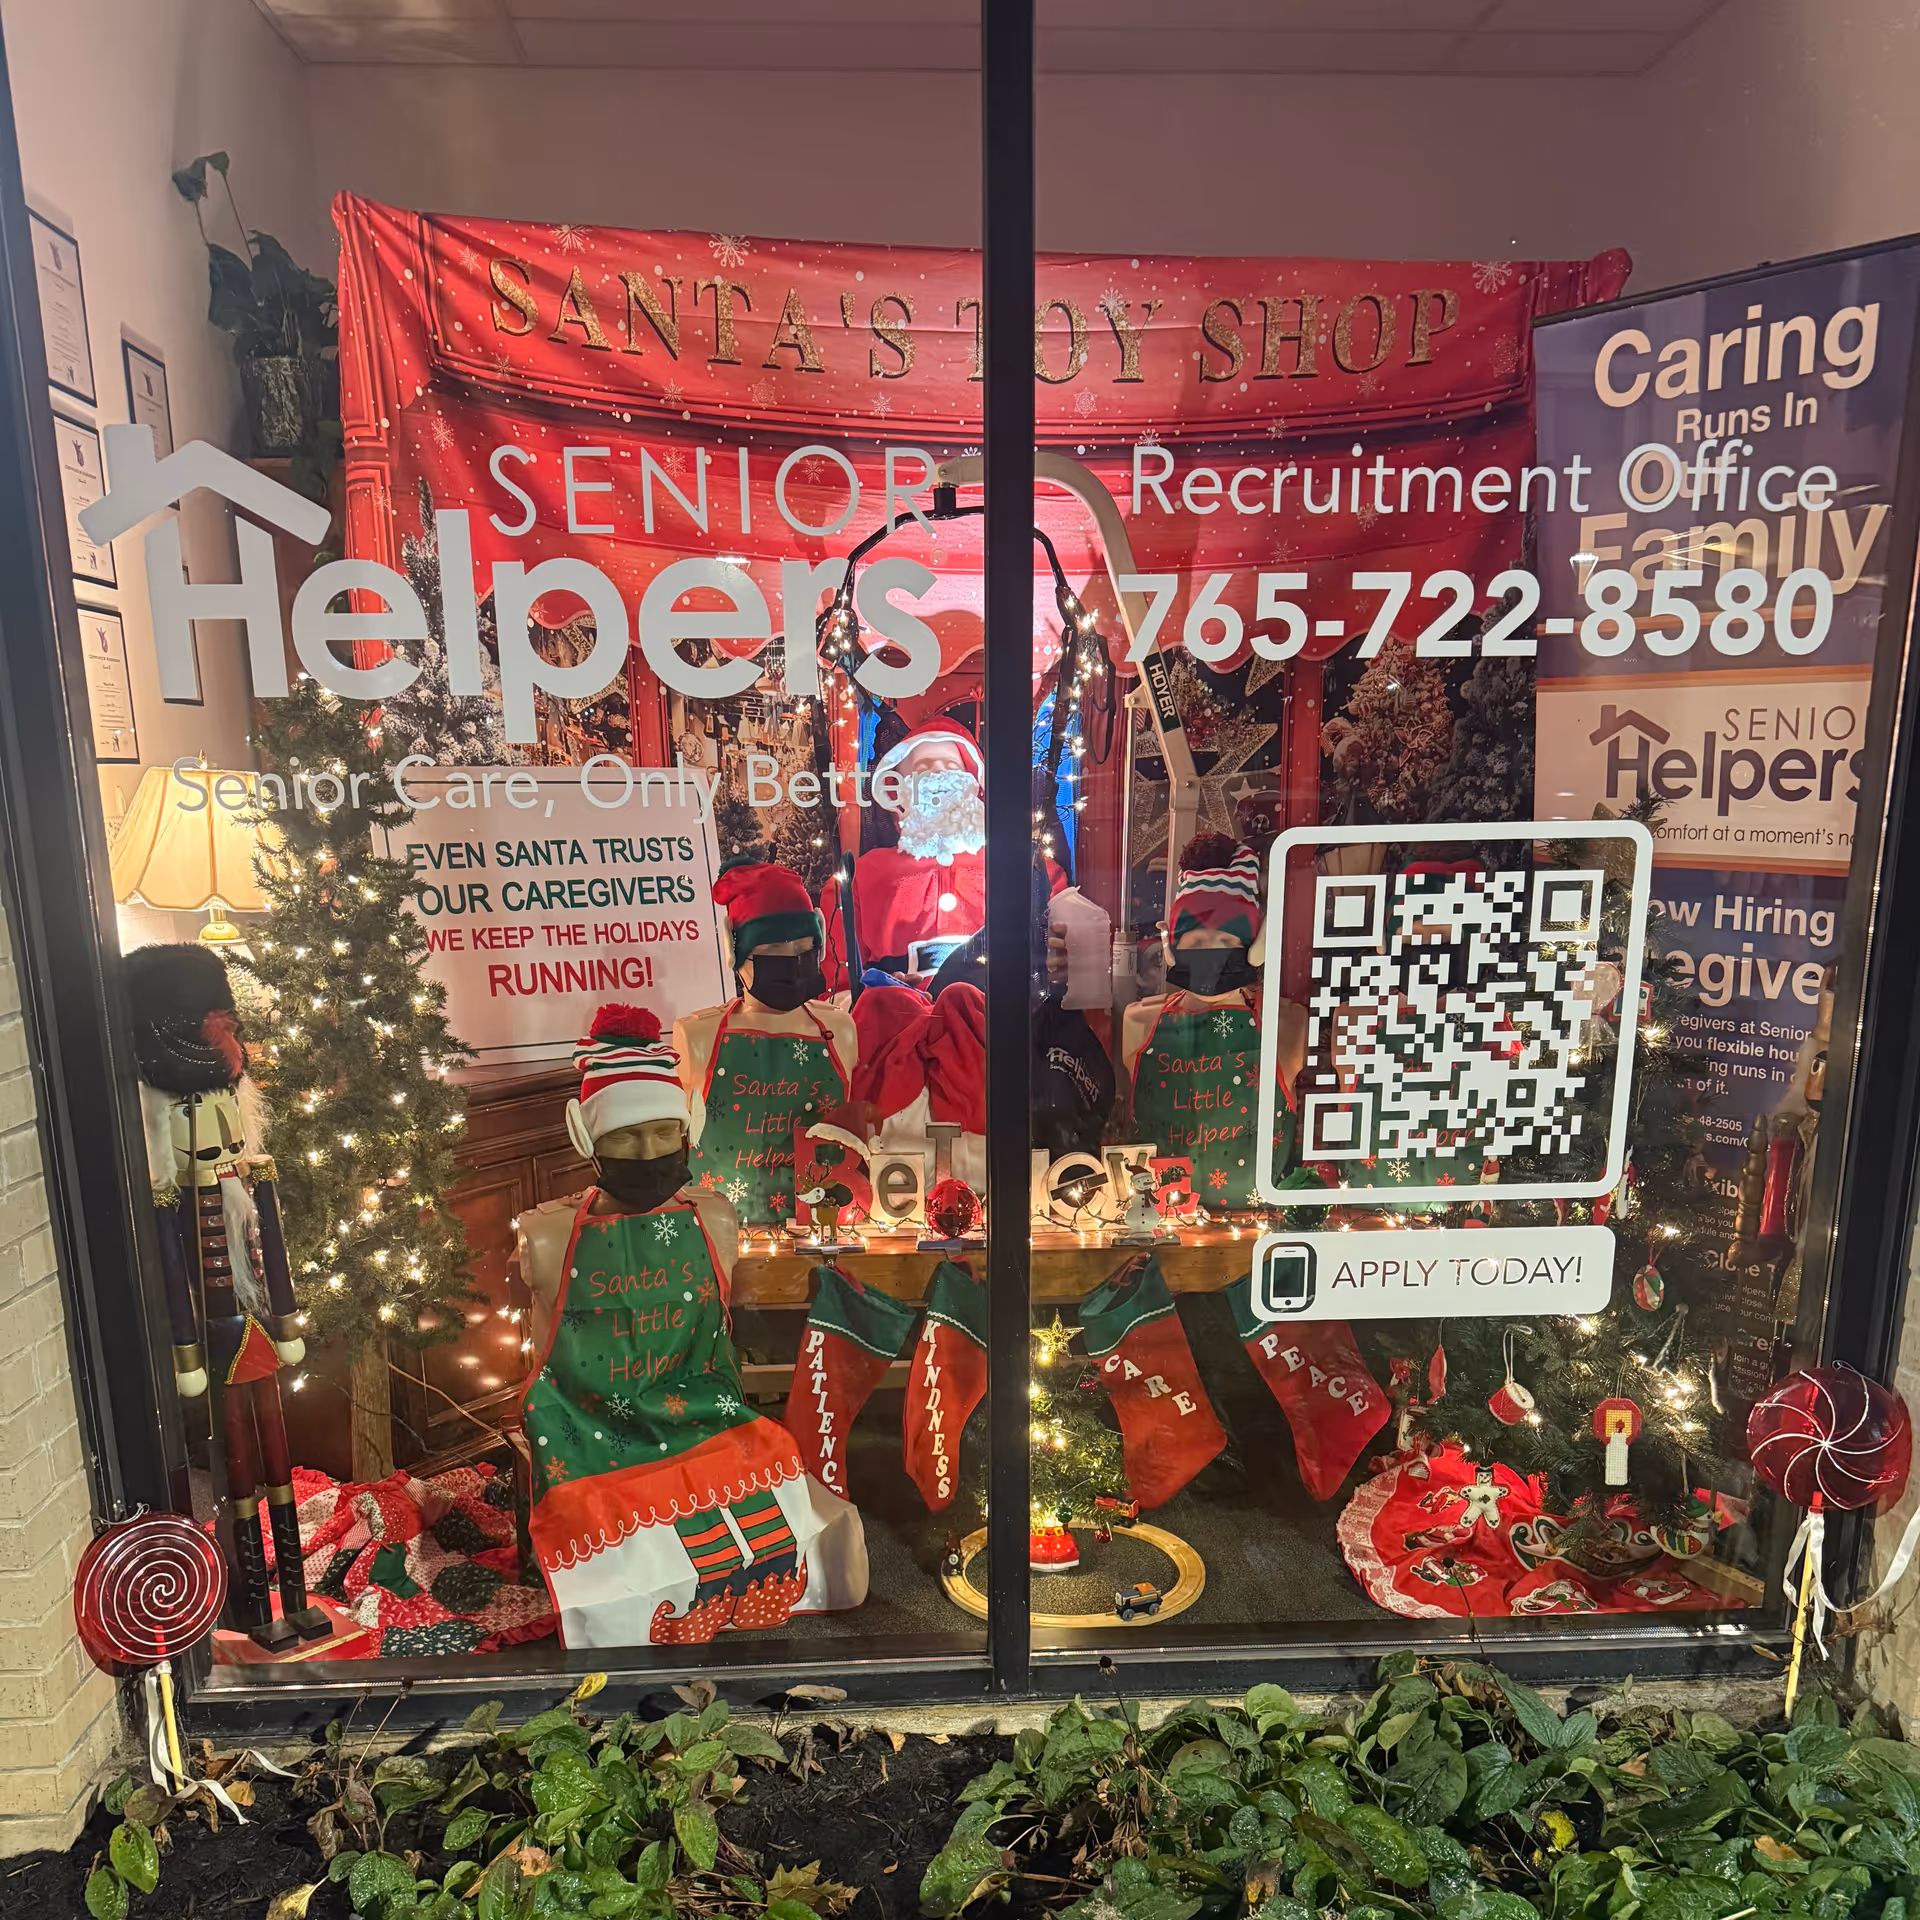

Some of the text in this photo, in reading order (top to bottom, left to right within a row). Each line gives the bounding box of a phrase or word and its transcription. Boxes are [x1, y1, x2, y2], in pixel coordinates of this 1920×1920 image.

[490, 257, 917, 379] SANTA'S
[1199, 288, 1460, 384] SHOP
[1594, 303, 1880, 408] Caring
[1676, 391, 1818, 444] Runs In
[488, 444, 937, 537] SENIOR
[1132, 438, 1838, 515] Recruitment Office
[1577, 490, 1892, 596] Family
[145, 508, 942, 744] Helpers
[1117, 567, 1834, 663] 765-722-8580
[1149, 663, 1176, 719] HOYER
[1722, 704, 1856, 742] SENIO
[172, 752, 942, 824] Senior Care, Only Better.
[406, 836, 695, 870] EVEN SANTA TRUSTS
[1712, 825, 1729, 842] at
[1734, 829, 1745, 842] a
[1749, 828, 1834, 846] moment's
[417, 874, 696, 916] OUR CAREGIVERS
[424, 919, 700, 953] WE KEEP THE HOLIDAYS
[1647, 894, 1836, 948] ow Hiring
[487, 956, 654, 998] RUNNING!
[1679, 1014, 1812, 1042] egivers at Senior
[1157, 1050, 1246, 1075] Santa's
[1675, 1035, 1703, 1050] you
[1706, 1036, 1765, 1058] flexible
[1768, 1044, 1800, 1063] hou
[732, 1073, 821, 1098] Santa's
[1696, 1079, 1712, 1091] of
[1715, 1079, 1729, 1095] it.
[1732, 1062, 1767, 1080] runs
[1771, 1066, 1785, 1083] in
[1172, 1085, 1235, 1111] Little
[744, 1112, 802, 1135] Little
[1168, 1123, 1245, 1152] Helper
[734, 1148, 795, 1176] Helpe
[588, 1258, 695, 1298] Santa's
[1330, 1256, 1582, 1289] APPLY TODAY!
[612, 1301, 686, 1338] Little
[1104, 1353, 1198, 1416] CARE
[1258, 1333, 1370, 1417] PEACE
[922, 1318, 951, 1499] KINDNESS
